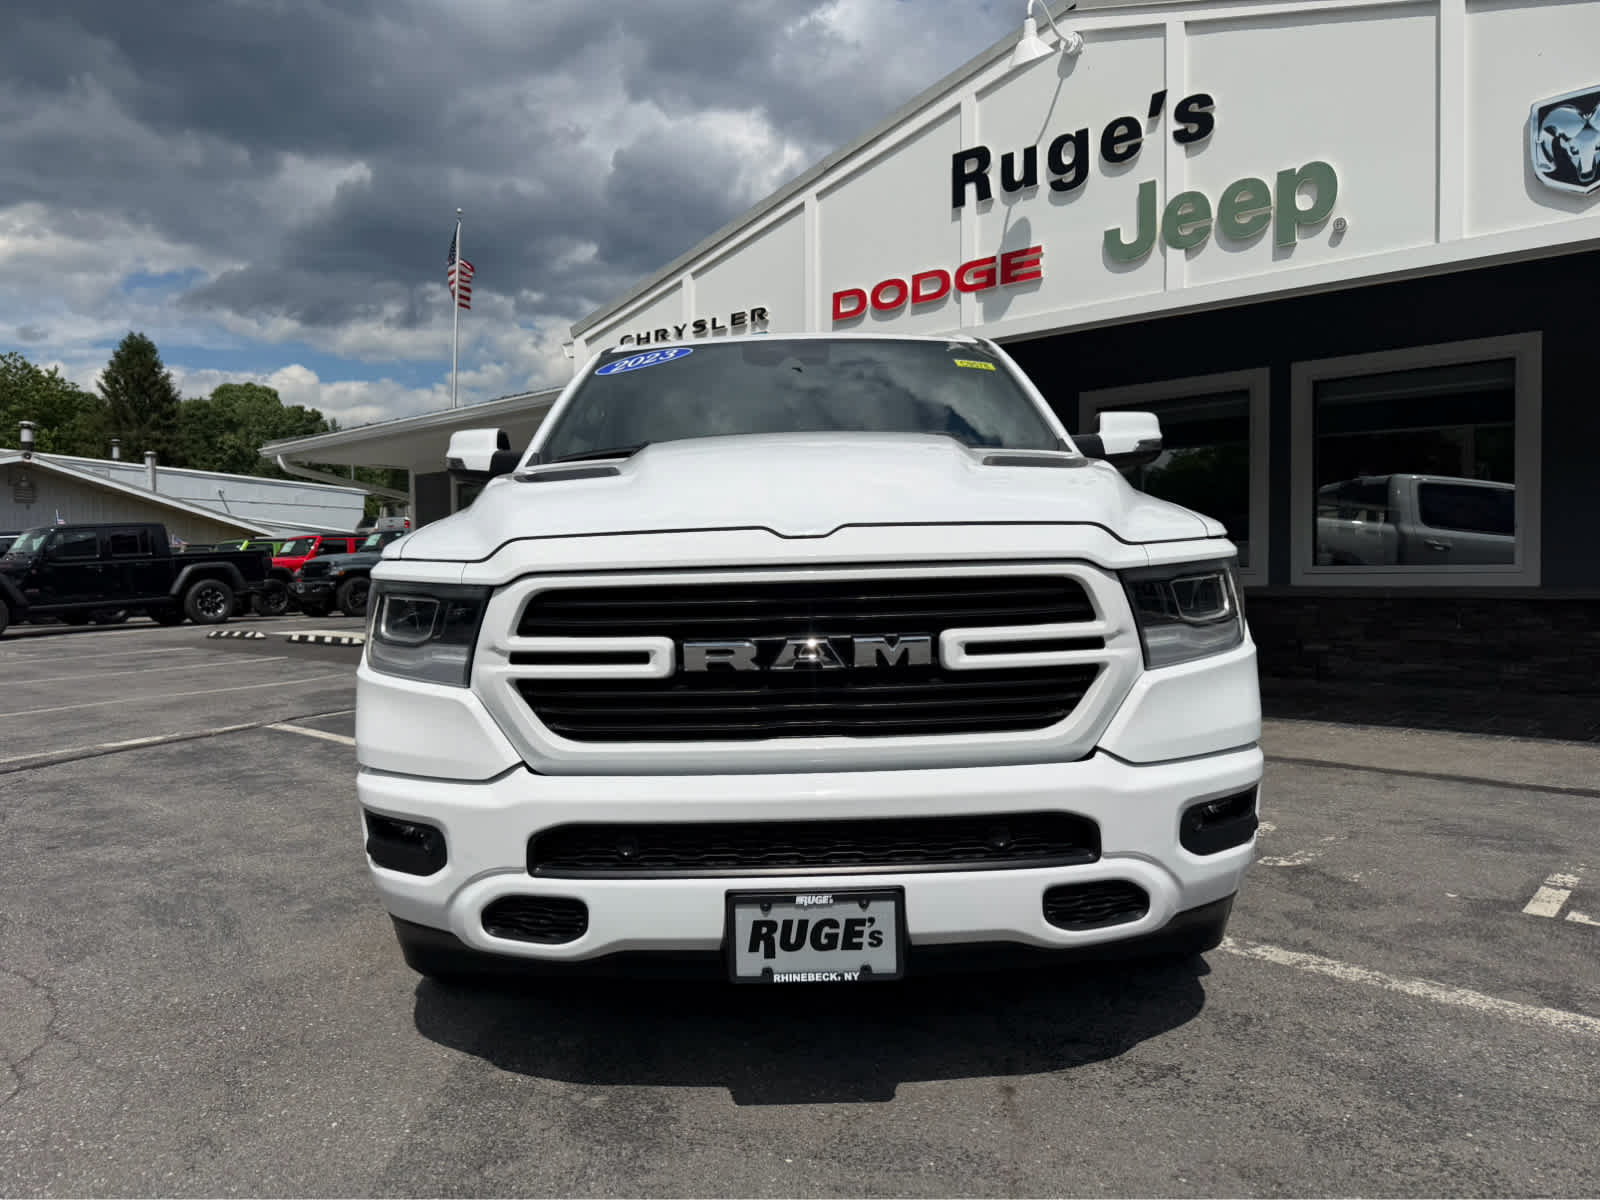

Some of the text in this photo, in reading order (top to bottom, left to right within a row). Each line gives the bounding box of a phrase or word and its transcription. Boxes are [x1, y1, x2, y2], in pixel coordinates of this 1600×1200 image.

[952, 89, 1215, 209] Ruge's
[832, 245, 1043, 320] DODGE
[619, 307, 769, 346] CHRYSLER
[609, 349, 680, 374] 2023
[683, 635, 932, 671] RAM
[773, 972, 860, 983] RHINEBECK, NY
